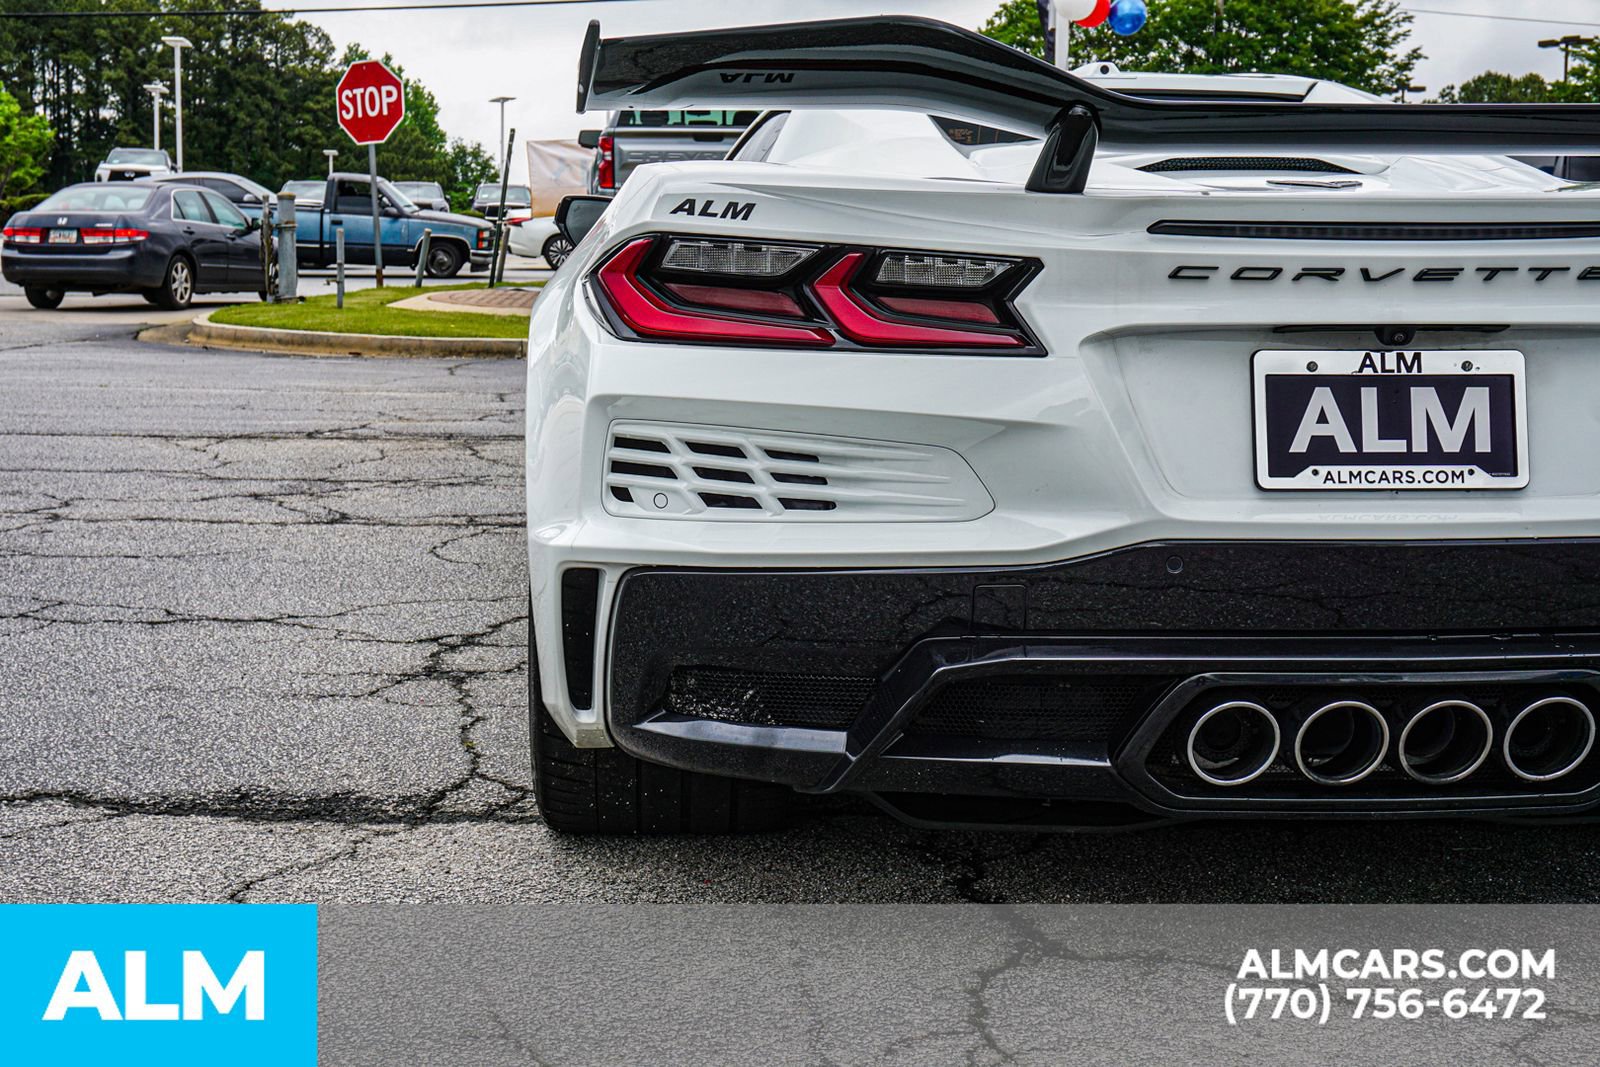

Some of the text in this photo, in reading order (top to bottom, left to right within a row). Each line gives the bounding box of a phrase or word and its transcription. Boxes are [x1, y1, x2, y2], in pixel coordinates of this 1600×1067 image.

[341, 85, 398, 120] STOP
[669, 198, 757, 221] ALM
[1357, 352, 1422, 374] ALM
[1288, 386, 1491, 453] ALM
[1323, 470, 1465, 484] ALMCARS.COM
